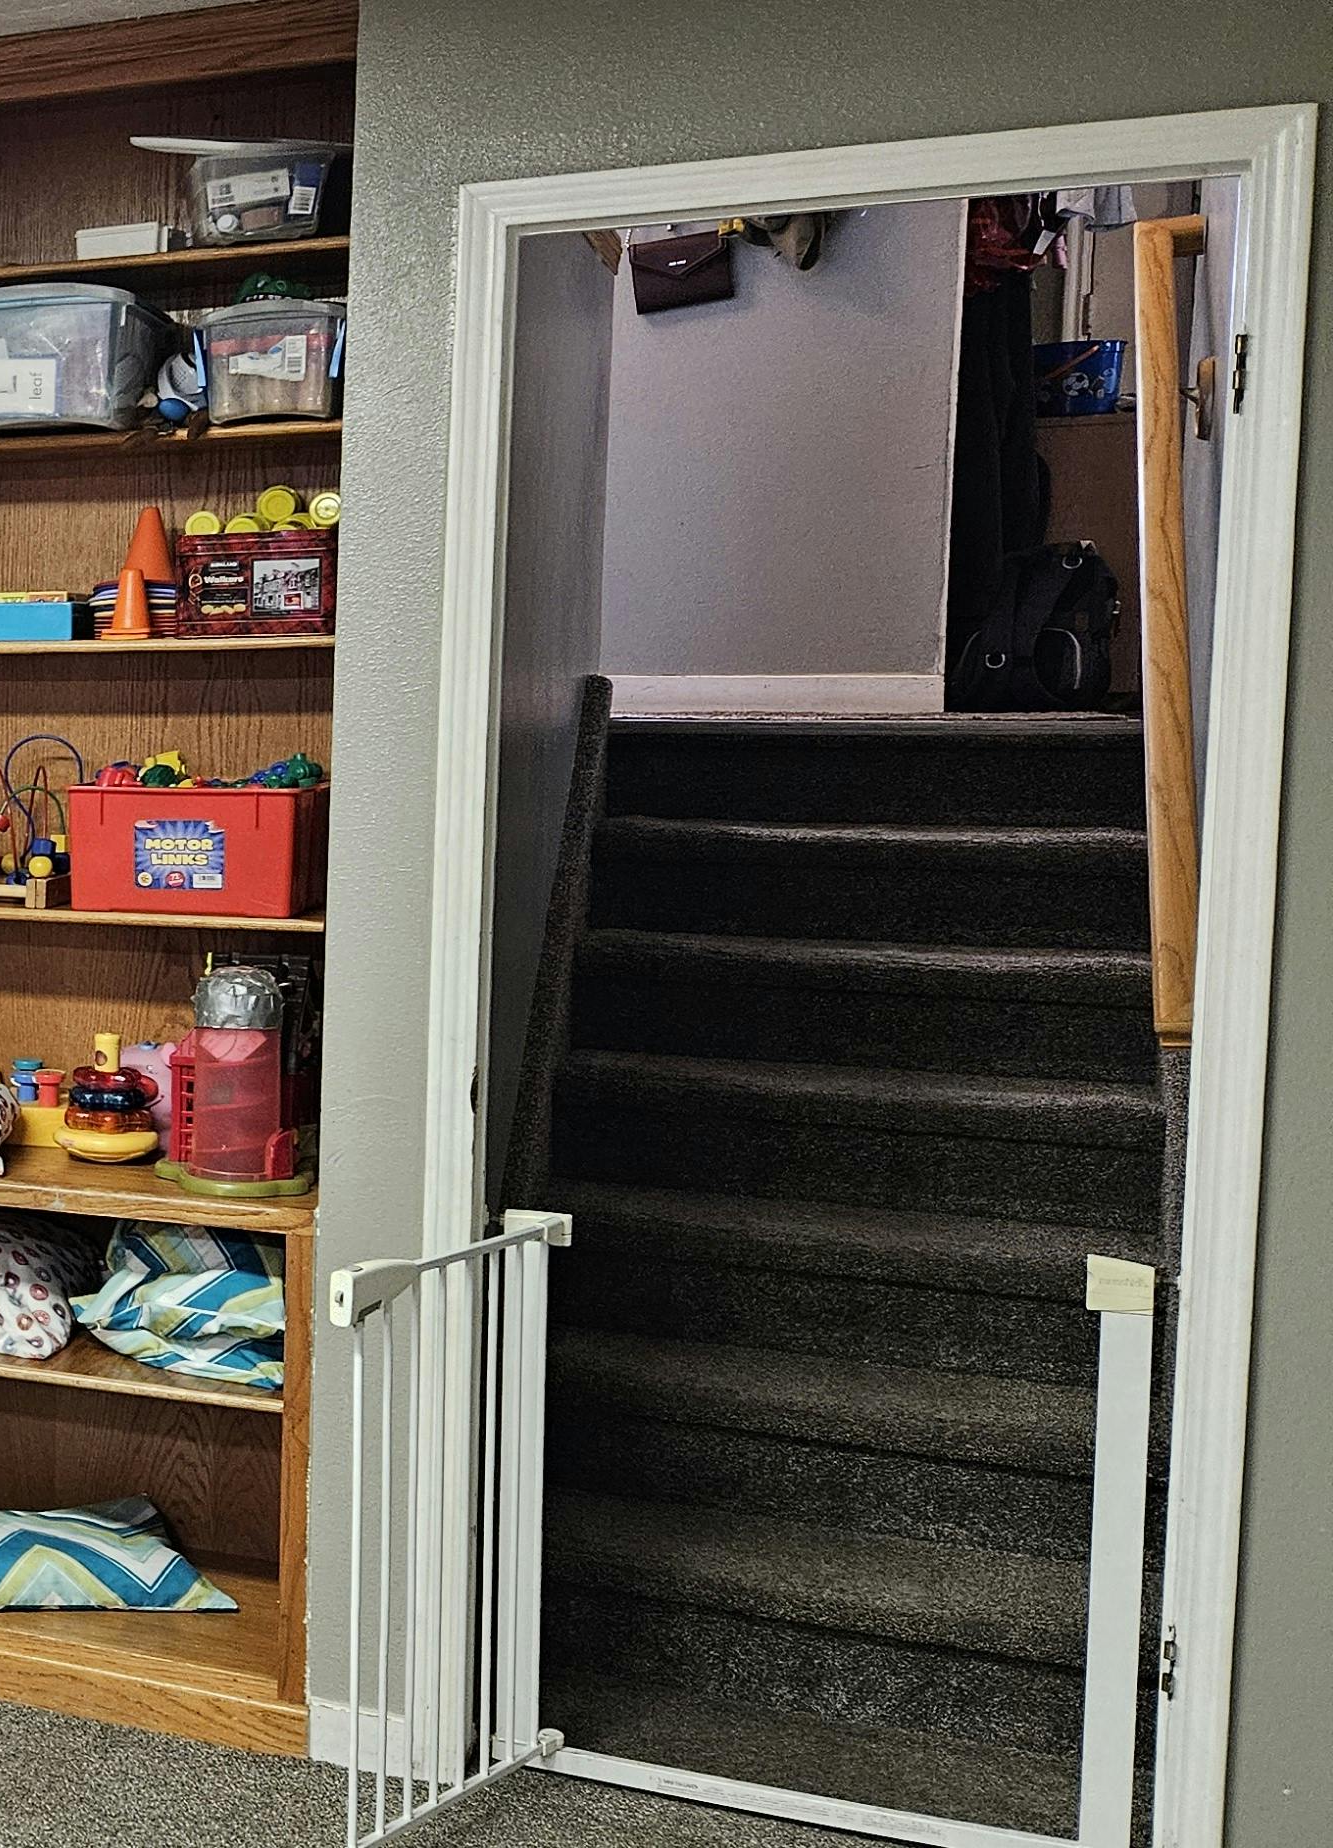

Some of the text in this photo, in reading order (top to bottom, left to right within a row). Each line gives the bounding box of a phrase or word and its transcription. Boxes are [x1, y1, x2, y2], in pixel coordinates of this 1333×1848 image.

[29, 370, 43, 399] leaf
[144, 838, 214, 851] MOTOR
[150, 852, 209, 866] LINKS
